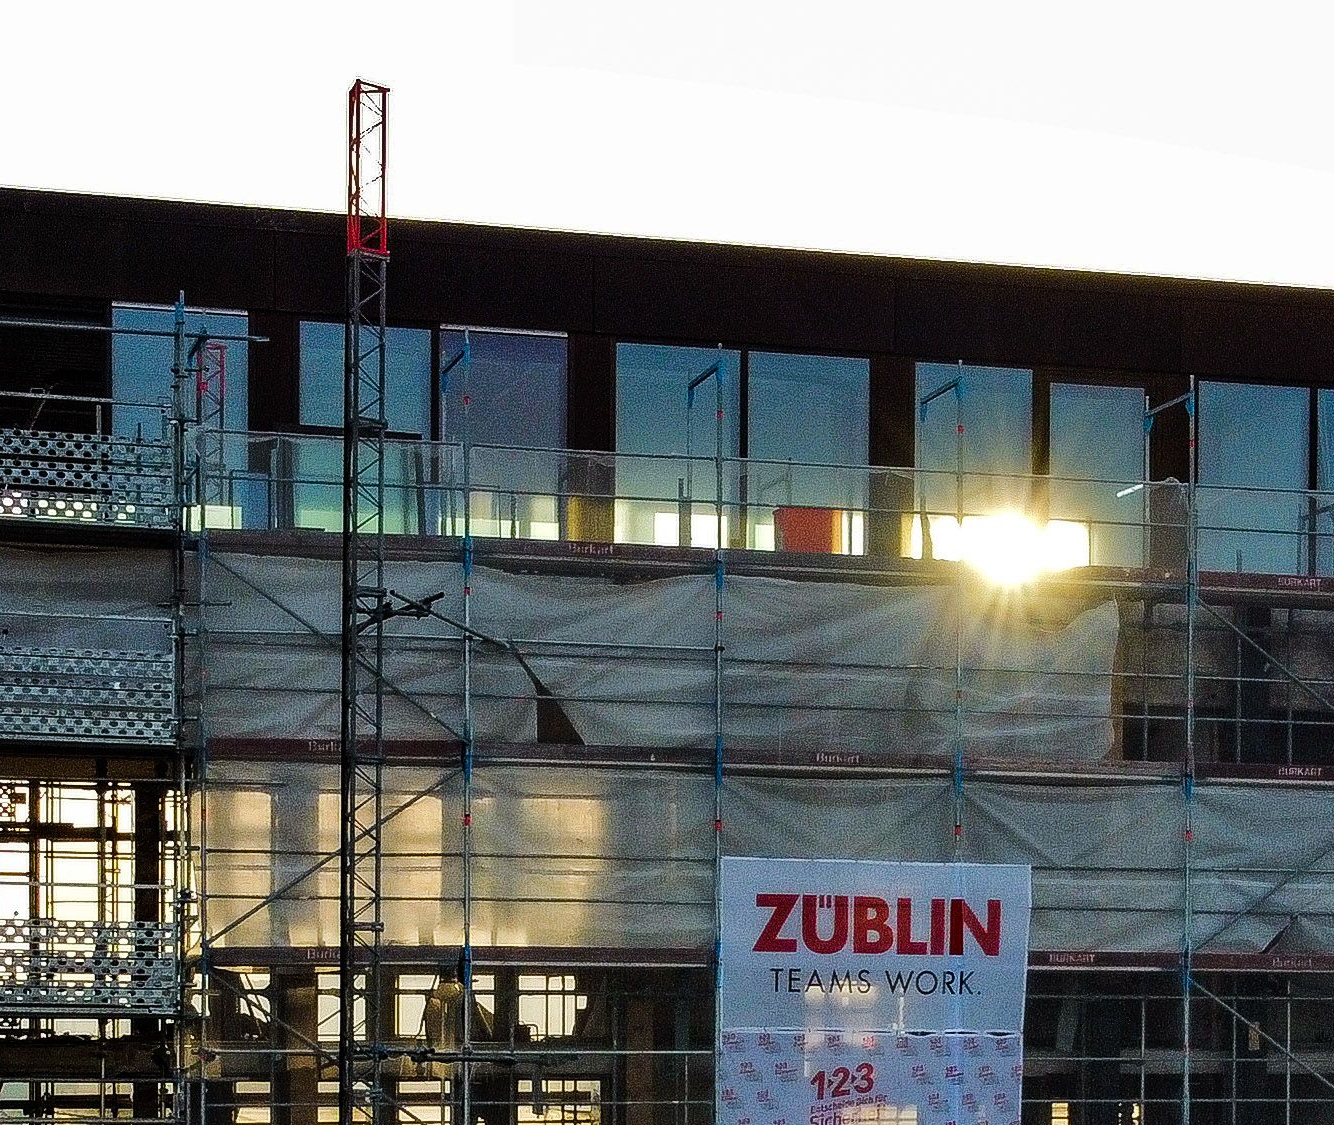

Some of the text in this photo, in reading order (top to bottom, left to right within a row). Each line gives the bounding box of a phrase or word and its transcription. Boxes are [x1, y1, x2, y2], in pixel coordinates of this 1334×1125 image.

[753, 893, 1002, 957] ZÜBLIN
[770, 967, 982, 996] TEAMS WORK.
